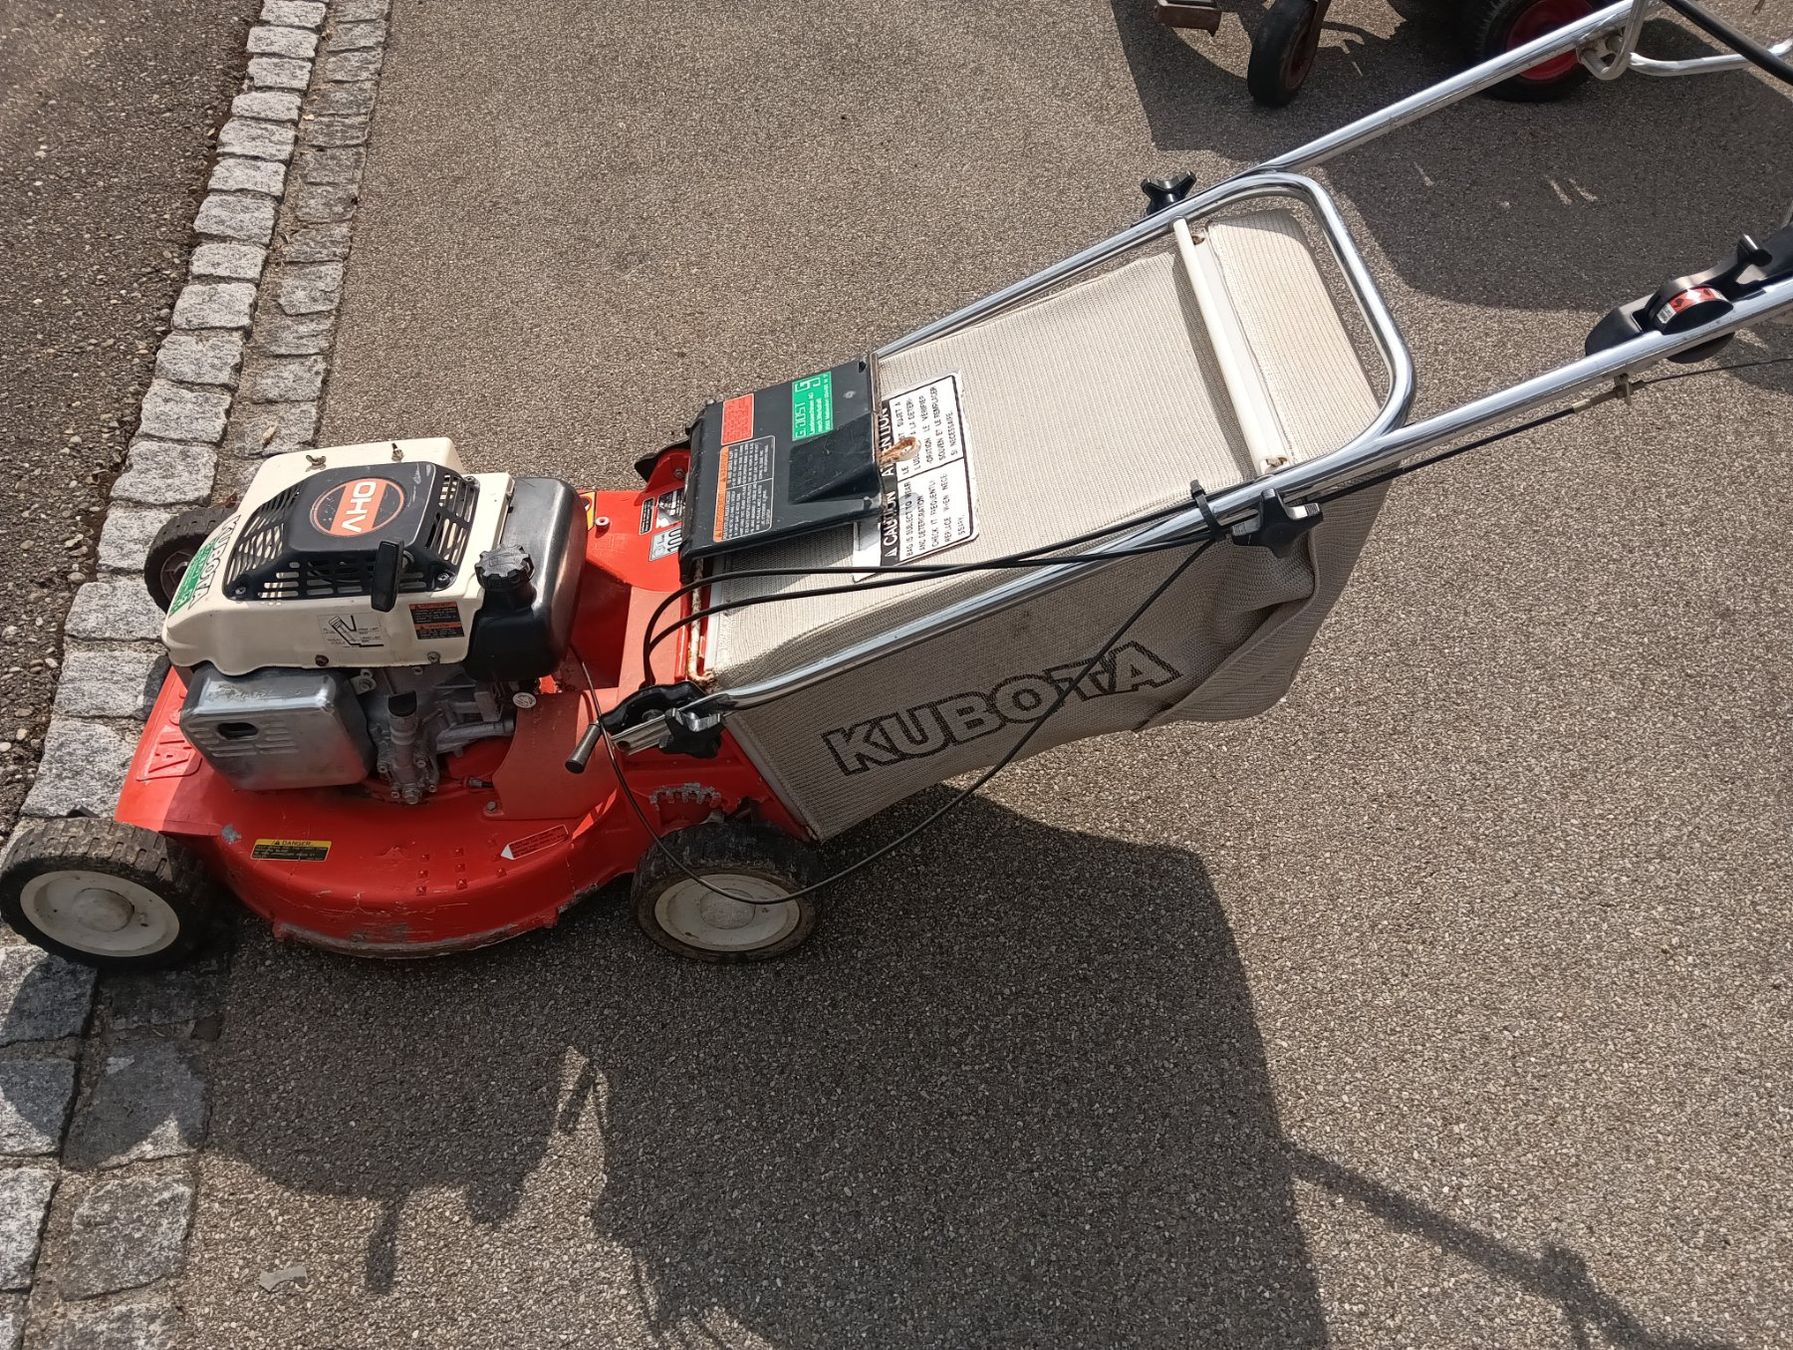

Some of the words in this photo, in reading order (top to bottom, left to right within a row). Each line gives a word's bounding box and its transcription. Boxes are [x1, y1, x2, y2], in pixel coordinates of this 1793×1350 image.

[921, 423, 930, 433] LE
[933, 418, 942, 427] LE
[900, 464, 909, 475] LE
[341, 481, 377, 533] OHV
[904, 499, 913, 510] TO
[880, 489, 899, 547] CAUTION
[929, 517, 938, 525] IT
[929, 526, 940, 548] CHECK
[188, 513, 242, 611] KUBOTA
[820, 640, 1183, 757] KUBOTA
